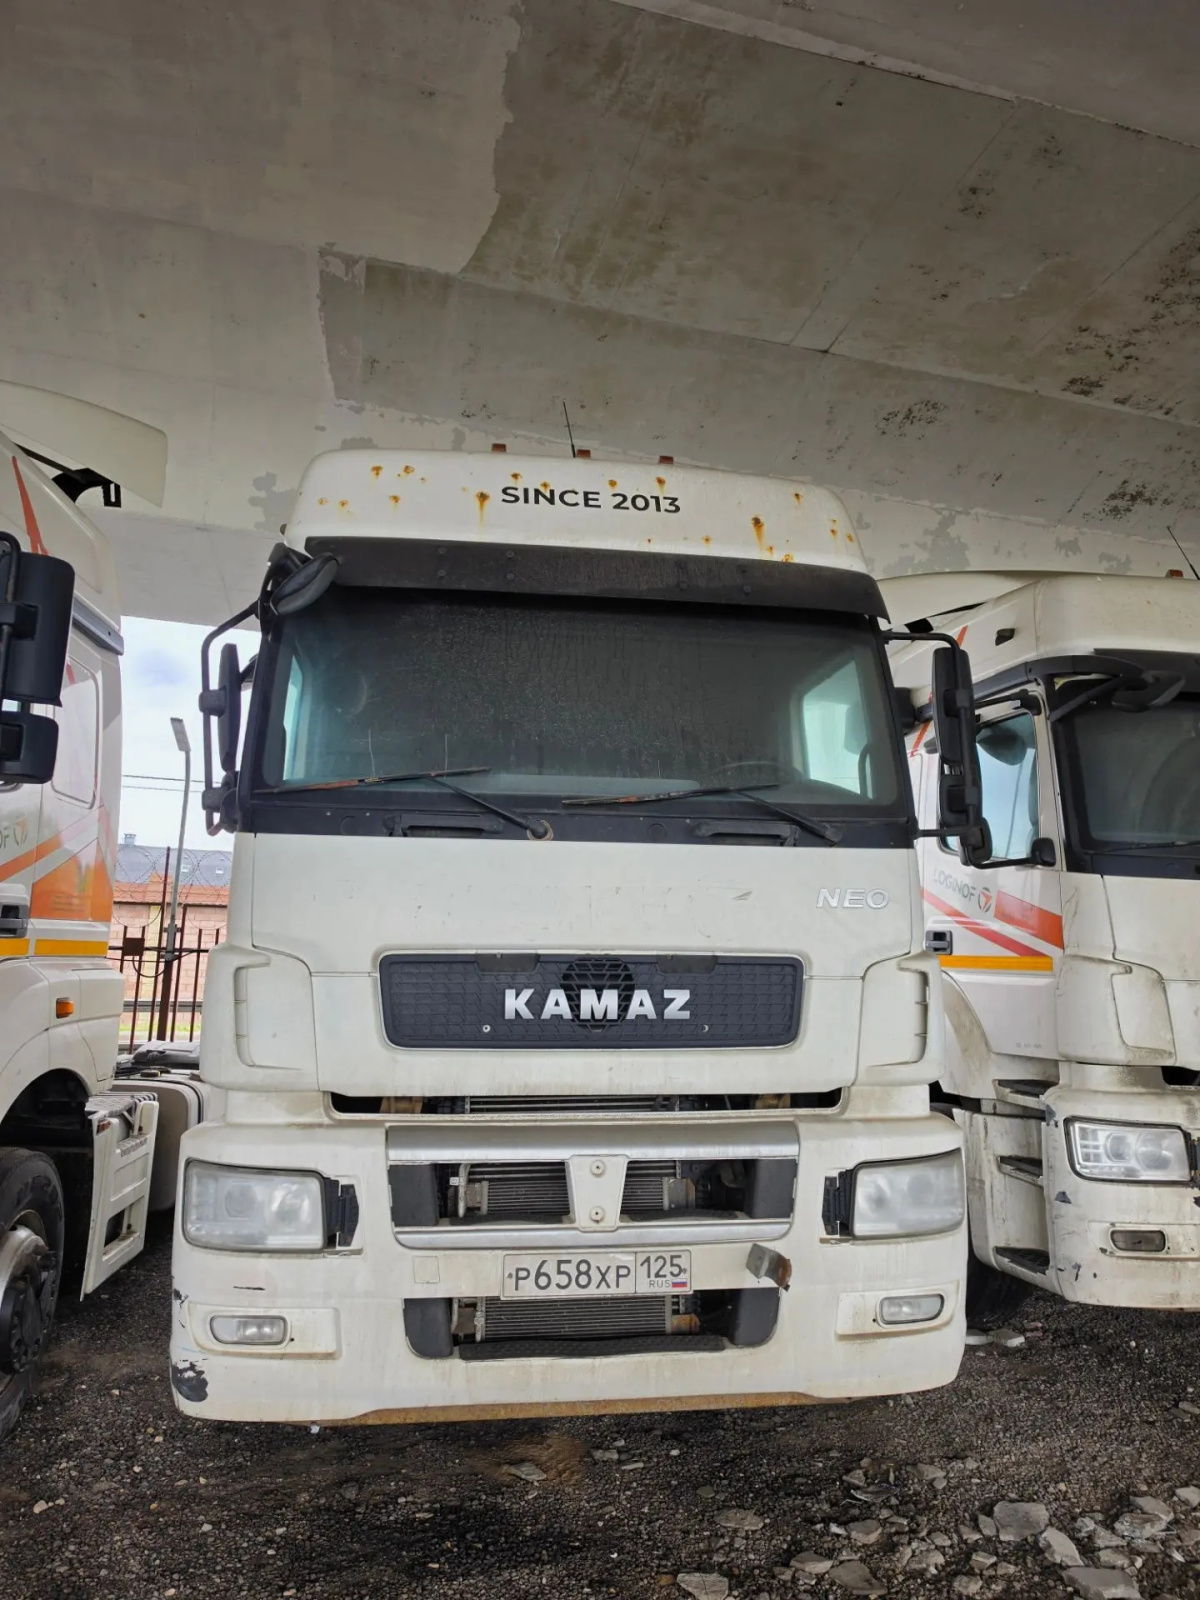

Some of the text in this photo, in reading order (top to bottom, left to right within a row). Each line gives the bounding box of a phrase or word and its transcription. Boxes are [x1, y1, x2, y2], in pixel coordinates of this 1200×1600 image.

[501, 486, 681, 514] SINCE 2013
[816, 888, 890, 909] NEO
[504, 988, 691, 1020] KAMAZ
[640, 1254, 683, 1279] 125
[649, 1279, 671, 1289] RUS
